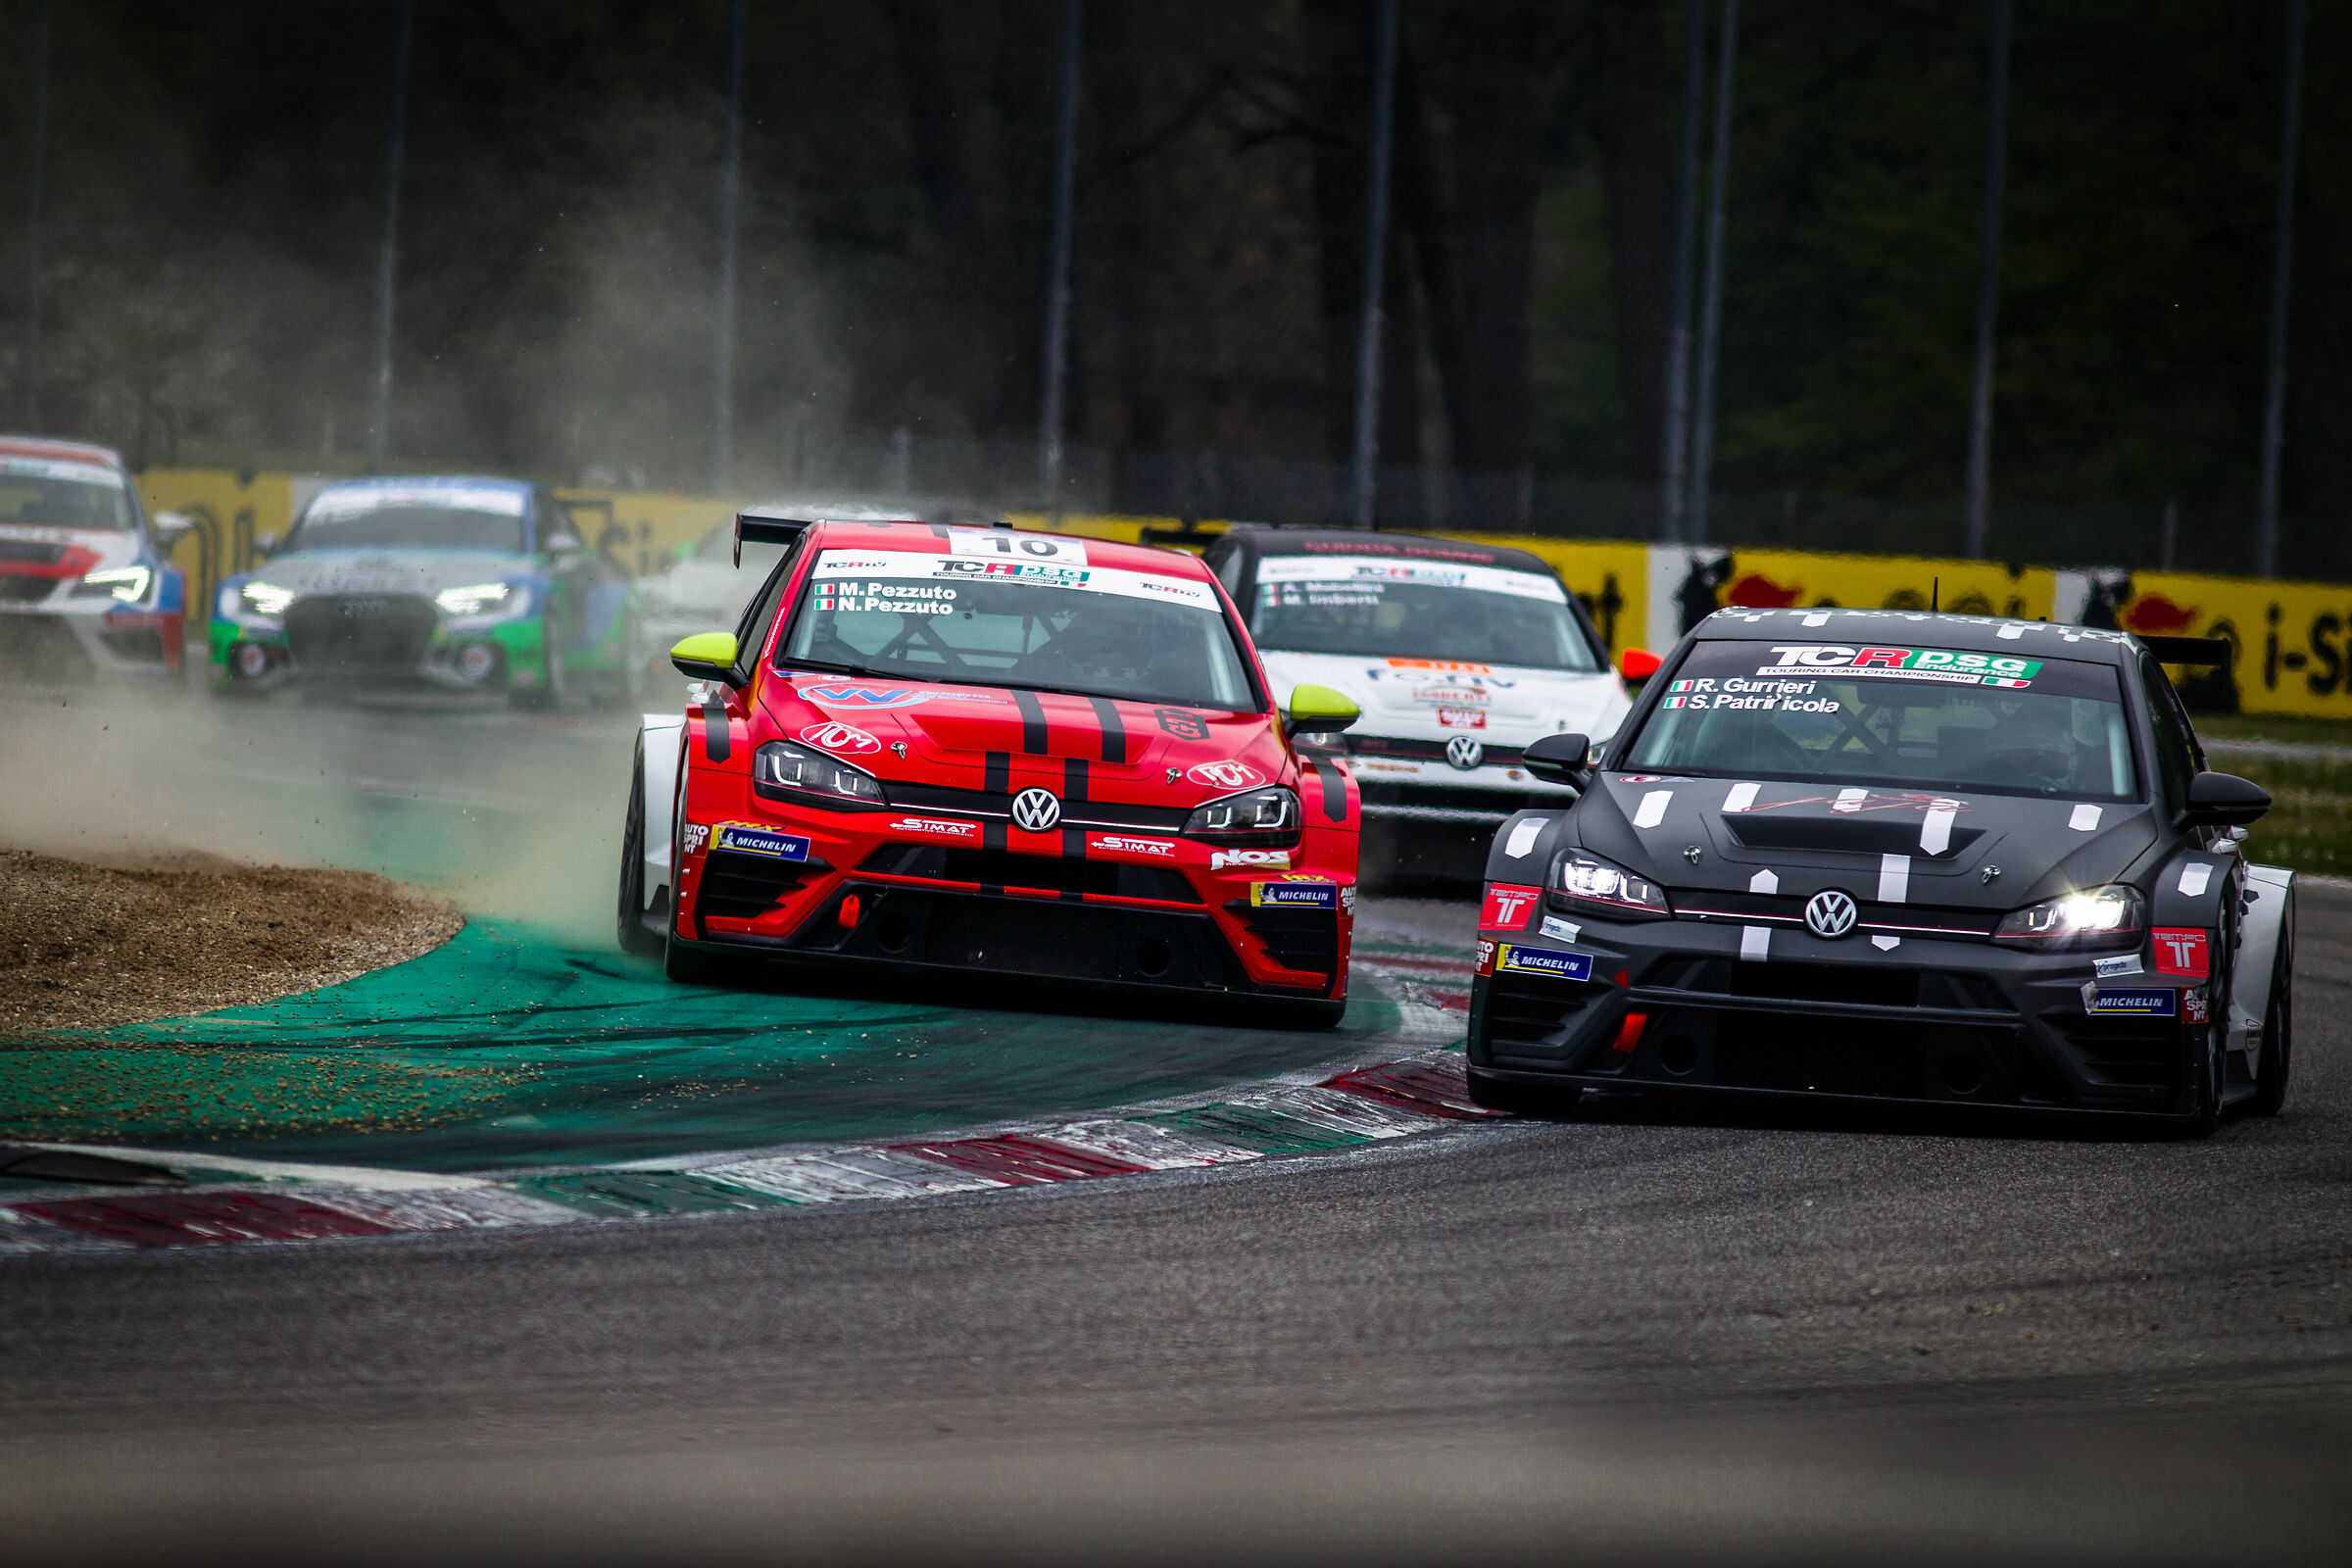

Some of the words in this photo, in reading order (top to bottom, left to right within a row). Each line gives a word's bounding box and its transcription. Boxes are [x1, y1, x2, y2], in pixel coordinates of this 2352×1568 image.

[982, 537, 1058, 557] 10
[839, 582, 865, 596] M.
[867, 583, 957, 600] Pezzuto
[838, 598, 862, 612] N.
[864, 598, 954, 614] Pezzuto
[1770, 646, 1912, 667] TCR
[1913, 652, 2028, 672] DSG
[1864, 669, 1975, 681] CHAMPIONSHIP
[1913, 662, 2022, 677] Endurance
[1693, 678, 1719, 692] R.
[1723, 677, 1817, 695] Gurrieri
[1689, 695, 1710, 710] S.
[902, 818, 970, 834] SIMAT
[736, 837, 796, 853] MICHELIN
[1102, 837, 1170, 853] SIMAT
[1210, 849, 1291, 870] NOS
[1279, 891, 1329, 901] MICHELIN
[1521, 956, 1579, 971] MICHELIN
[2099, 998, 2163, 1006] MICHELIN
